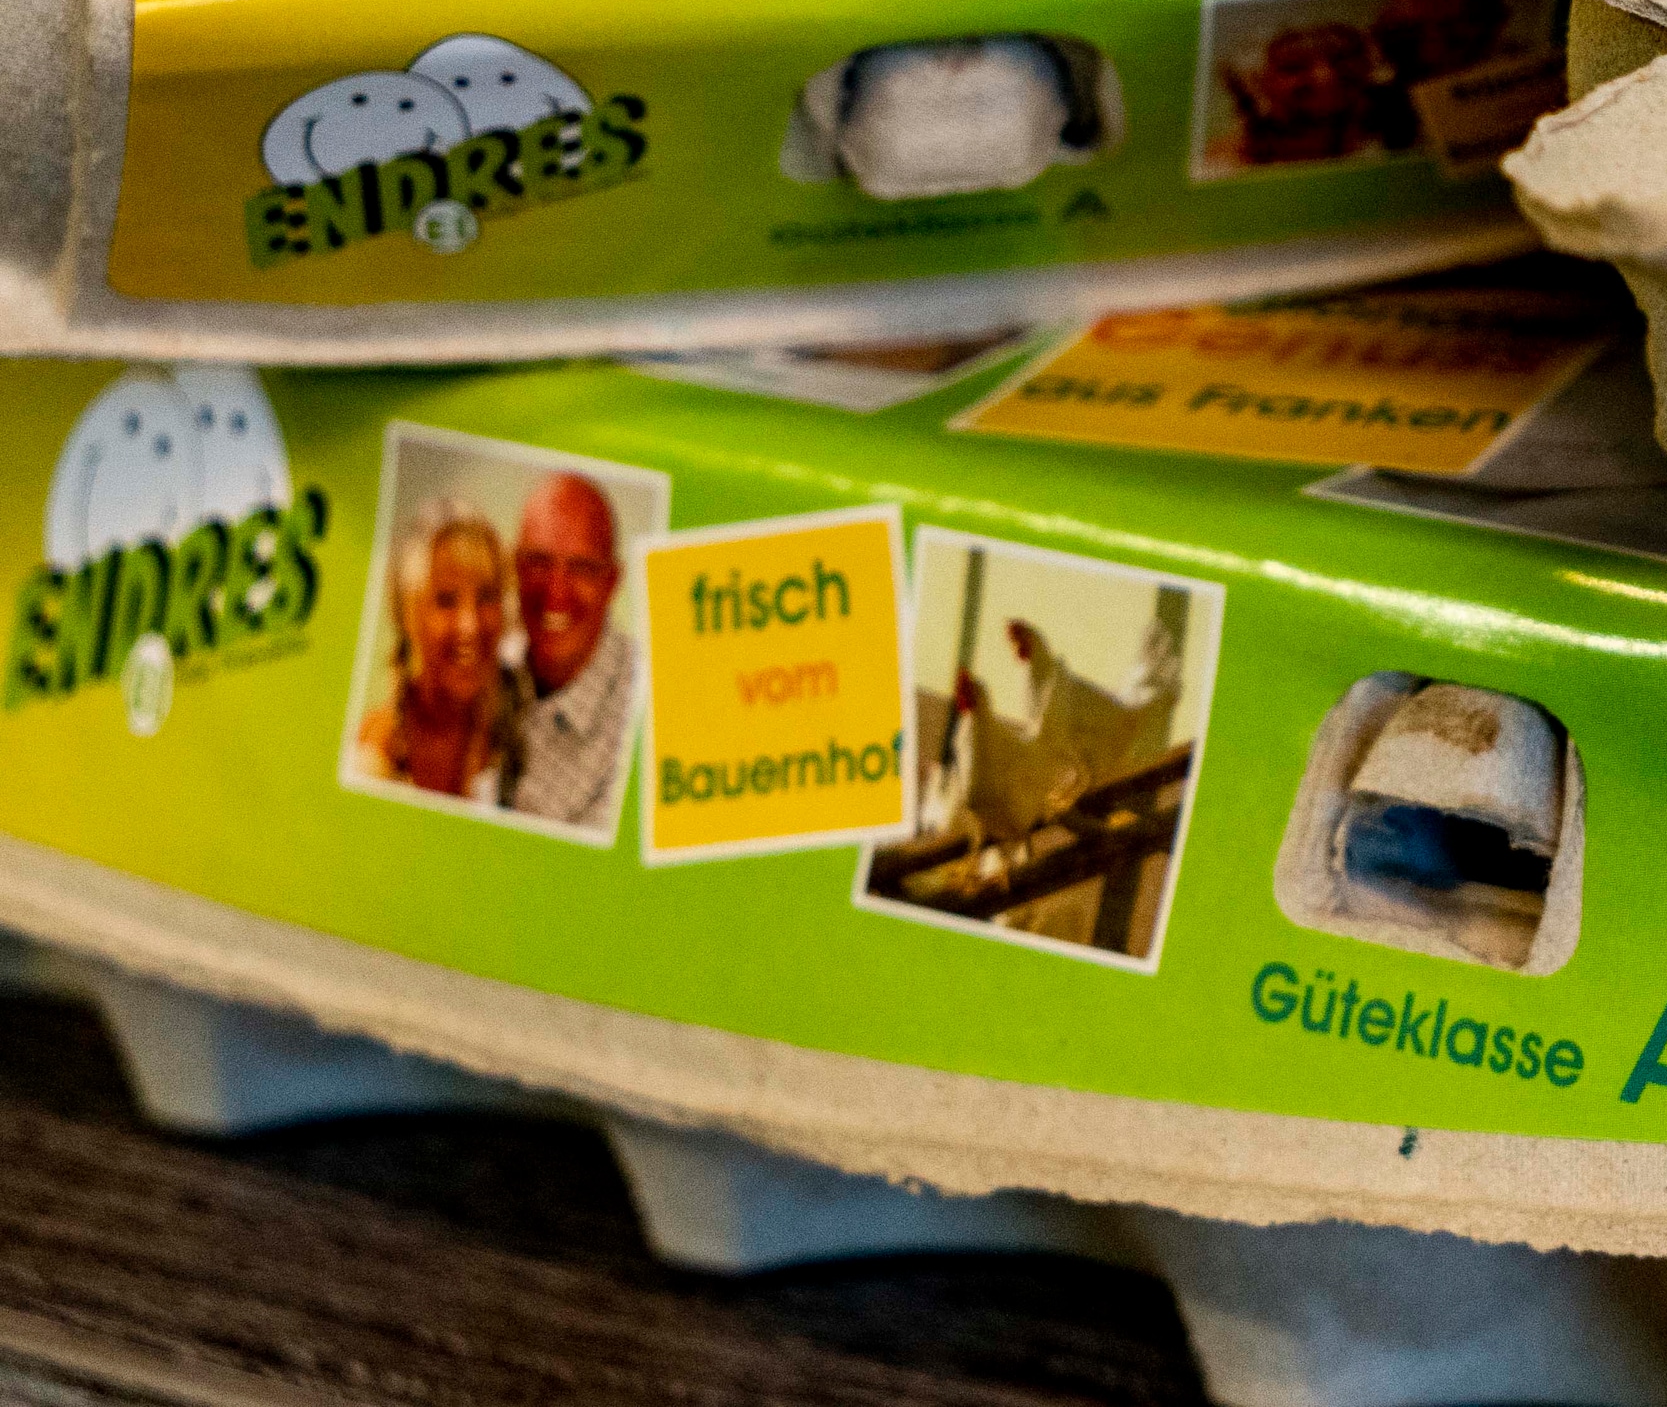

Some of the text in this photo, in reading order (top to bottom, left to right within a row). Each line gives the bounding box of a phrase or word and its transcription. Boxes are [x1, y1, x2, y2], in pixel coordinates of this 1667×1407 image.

[244, 93, 648, 270] ENDRES
[1018, 374, 1513, 434] aus Franken
[1, 484, 331, 715] ENDRES
[690, 557, 852, 635] frisch
[736, 660, 840, 708] vom
[1250, 961, 1586, 1088] Güteklasse
